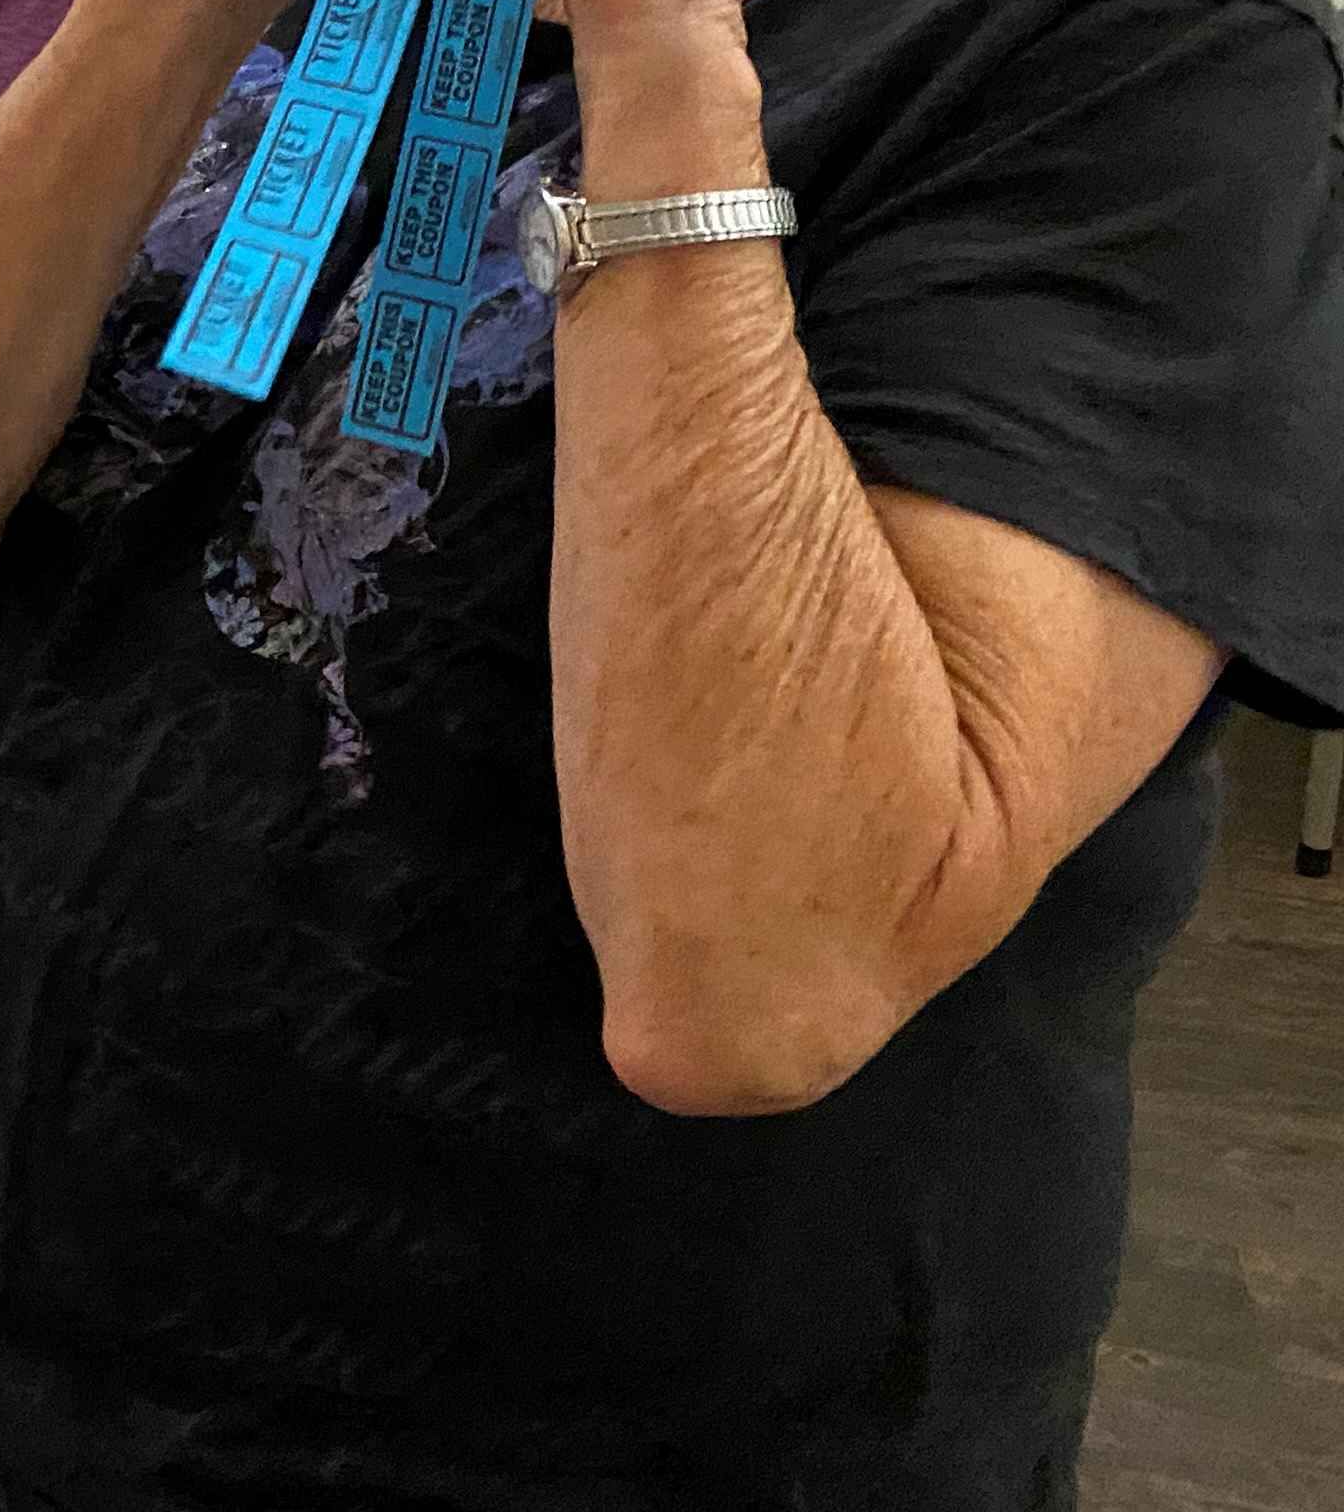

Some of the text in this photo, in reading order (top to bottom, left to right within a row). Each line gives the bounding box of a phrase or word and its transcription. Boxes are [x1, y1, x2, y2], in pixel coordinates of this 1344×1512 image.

[431, 47, 458, 108] KEEP
[453, 3, 490, 102] COUPON
[254, 122, 309, 207] TICKET
[397, 147, 438, 265] KEEP THIS
[416, 162, 454, 258] COUPON
[361, 302, 402, 422] KEEP THIS
[382, 317, 419, 413] COUPON
